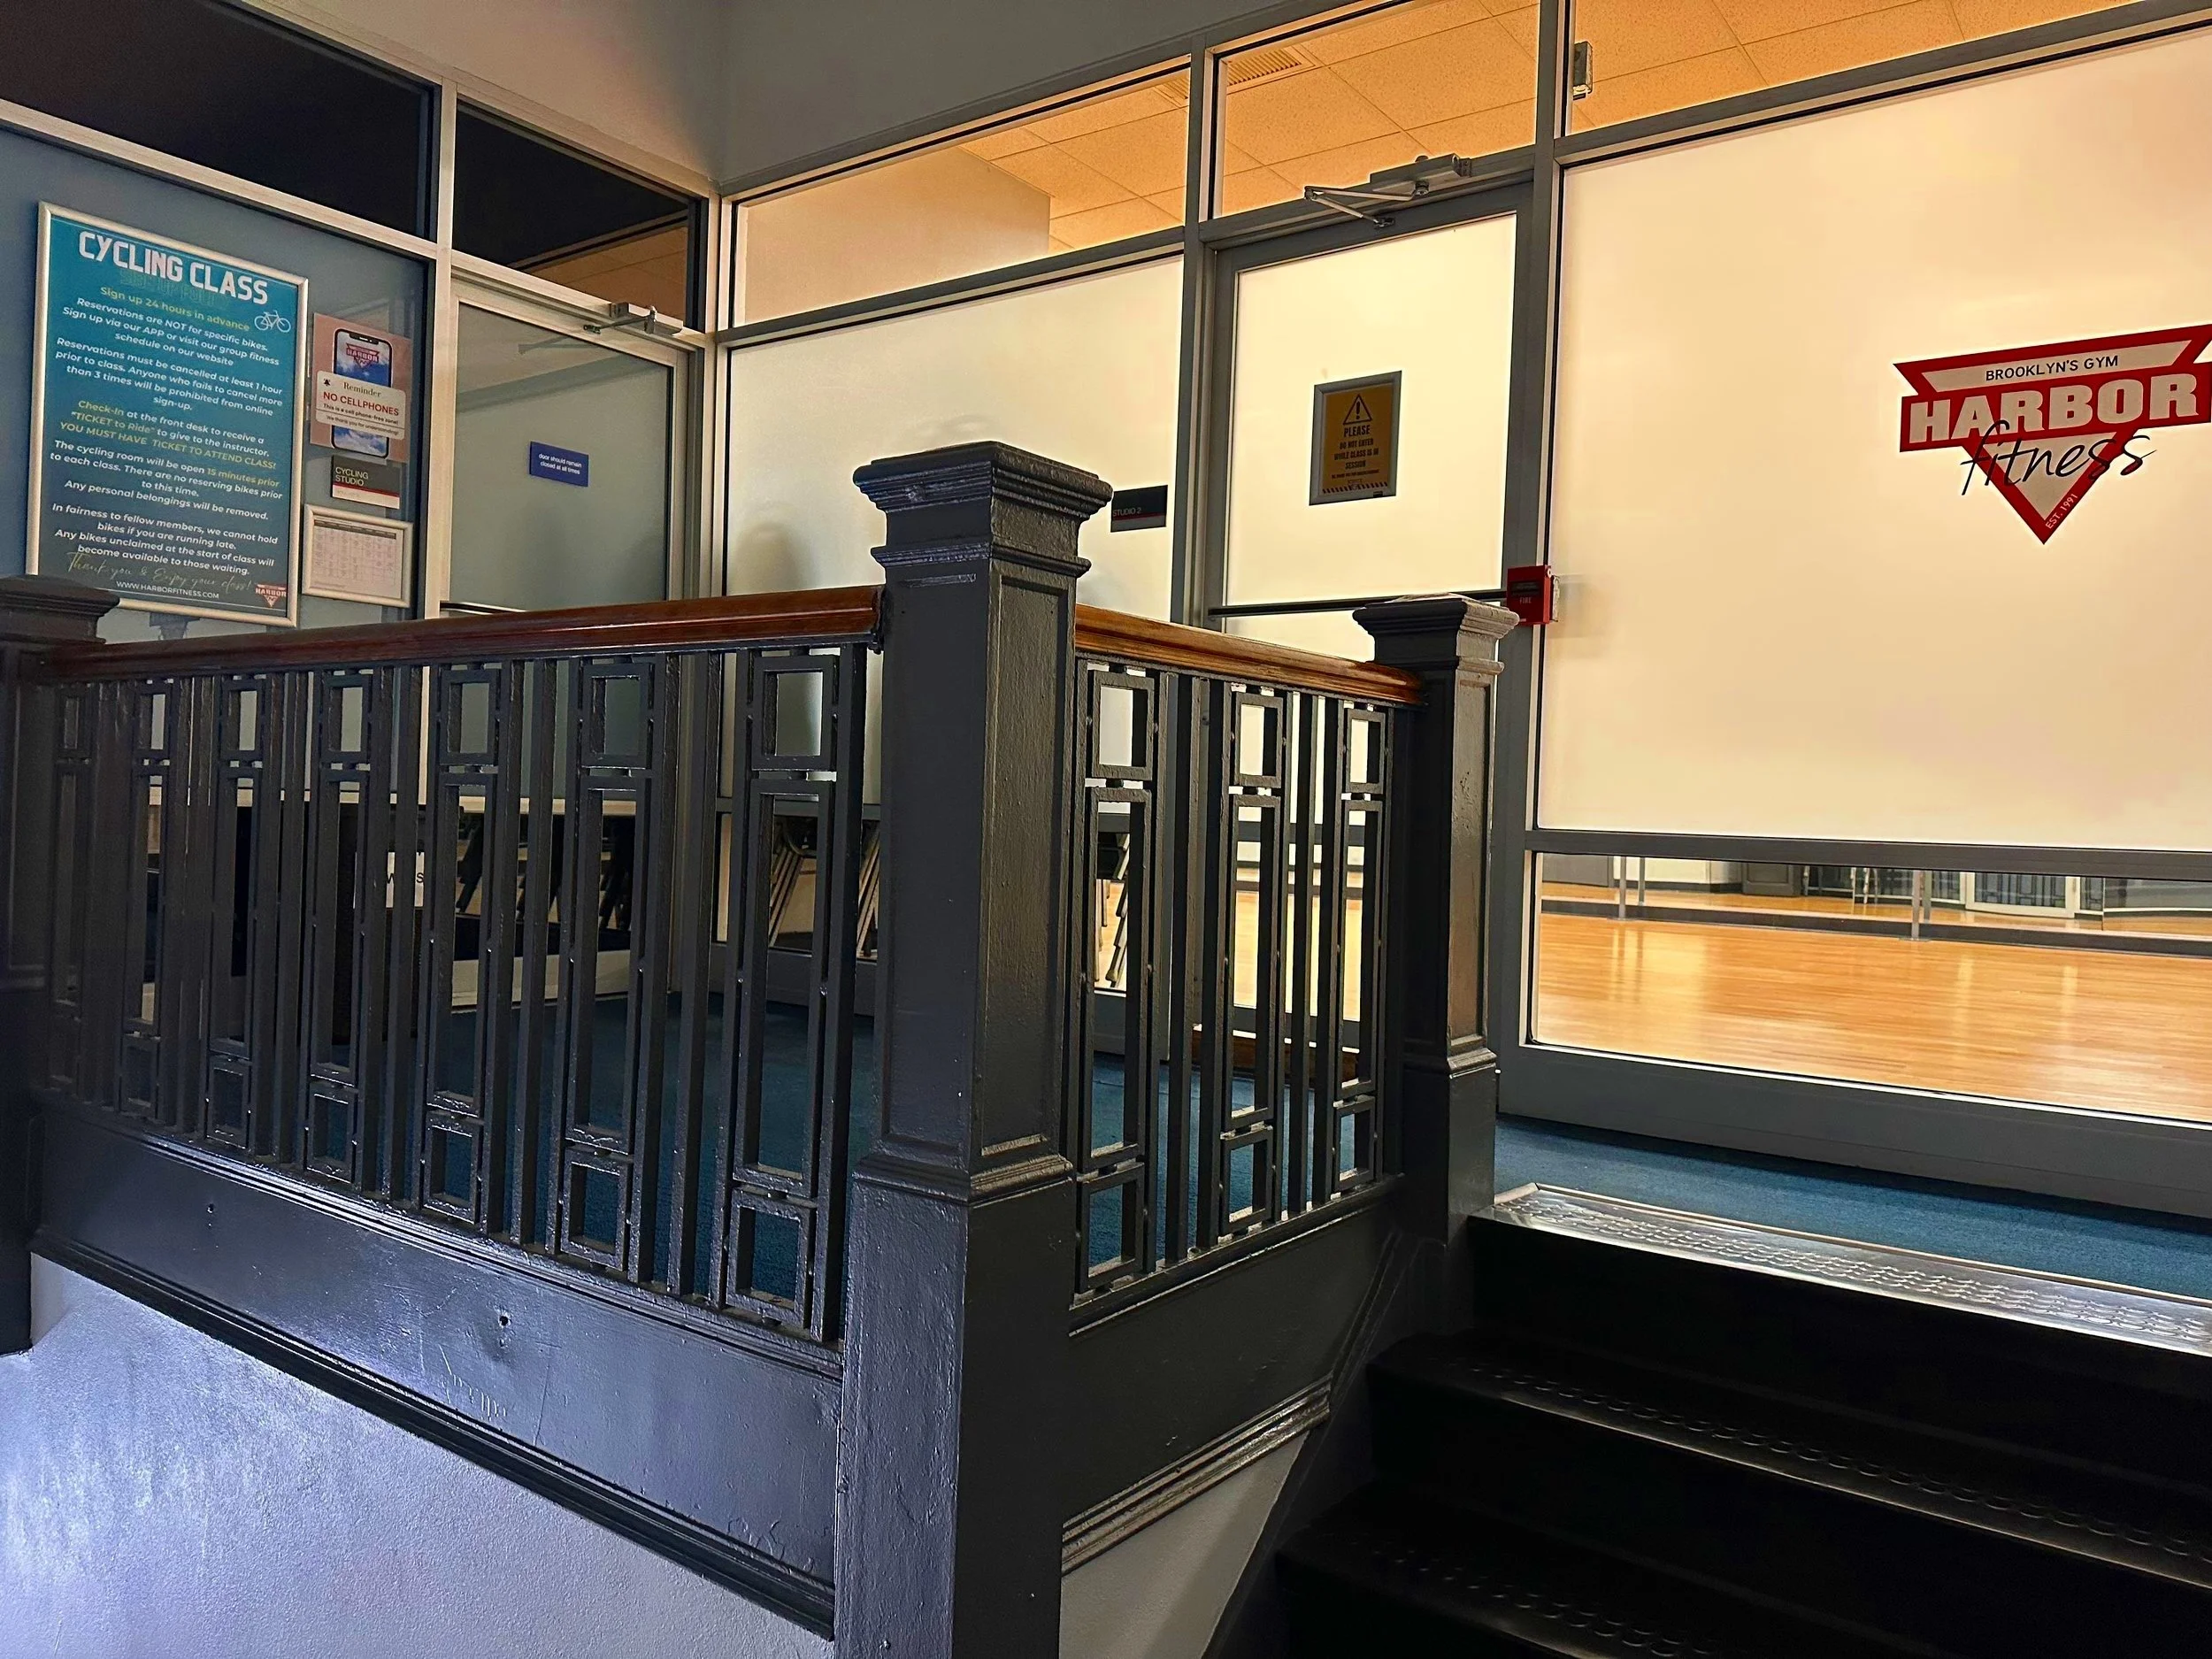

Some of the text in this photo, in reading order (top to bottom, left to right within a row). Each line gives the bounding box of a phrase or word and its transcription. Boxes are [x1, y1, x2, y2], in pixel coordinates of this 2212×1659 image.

[79, 231, 183, 281] CYCLING
[189, 262, 267, 304] CLASS
[77, 297, 267, 350] Reservations are NOT for specific bikes.
[100, 287, 250, 331] Sign up 24 hours in advance
[62, 307, 86, 319] Sign
[88, 314, 103, 324] up
[105, 318, 121, 327] via
[123, 323, 141, 332] our
[142, 326, 165, 336] APP
[179, 336, 199, 346] visit
[219, 346, 247, 358] group
[250, 352, 279, 365] fitness
[115, 334, 161, 349] schedule
[178, 348, 195, 357] our
[196, 352, 234, 365] website
[55, 351, 81, 362] prior
[97, 360, 126, 372] class.
[127, 366, 166, 380] Anyone
[169, 376, 190, 386] who
[192, 380, 212, 391] fails
[227, 389, 257, 401] cancel
[258, 396, 282, 406] more
[57, 337, 125, 359] Reservations
[127, 355, 153, 365] must
[155, 359, 168, 368] be
[170, 365, 217, 380] cancelled
[231, 377, 253, 388] least
[261, 384, 282, 395] hour
[1985, 355, 2118, 380] BROOKLYN'S GYM
[66, 365, 91, 377] than
[103, 373, 132, 385] times
[134, 380, 152, 389] will
[168, 388, 219, 403] prohibited
[221, 398, 242, 409] from
[245, 405, 273, 416] online
[153, 396, 192, 411] sign-up.
[324, 392, 399, 416] NO CELLPHONES
[343, 382, 381, 397] Reminder
[356, 411, 384, 421] phone-free
[1909, 373, 2199, 444] HARBOR
[140, 413, 157, 422] the
[159, 416, 184, 427] front
[186, 422, 208, 433] desk
[223, 431, 256, 442] receive
[1344, 425, 1370, 437] PLEASE
[60, 421, 276, 469] YOU MUST HAVE TICKET TO ATTEND CLASS!
[169, 432, 190, 441] give
[204, 438, 220, 447] the
[223, 441, 269, 457] instructor.
[1960, 419, 2157, 495] fitness
[55, 440, 74, 450] The
[76, 445, 114, 458] cycling
[116, 453, 143, 463] room
[146, 457, 164, 466] will
[165, 460, 179, 469] be
[180, 465, 204, 473] open
[218, 472, 256, 482] minutes
[335, 467, 368, 480] CYCLING
[64, 456, 90, 465] each
[93, 460, 120, 471] class.
[125, 465, 152, 476] There
[188, 478, 232, 492] reserving
[234, 484, 258, 495] bikes
[260, 490, 282, 499] prior
[154, 482, 173, 492] this
[175, 486, 199, 497] time.
[335, 474, 364, 487] STUDIO
[64, 480, 87, 491] Any
[88, 485, 134, 497] personal
[136, 491, 190, 508] belongings
[211, 503, 224, 512] be
[226, 508, 268, 519] removed.
[1113, 508, 1136, 517] STUDIO
[2046, 494, 2078, 528] EST. 1991
[65, 504, 107, 518] fairness
[123, 514, 154, 525] fellow
[156, 520, 204, 534] members,
[223, 531, 255, 541] cannot
[257, 534, 278, 544] hold
[97, 522, 125, 533] bikes
[175, 535, 214, 548] running
[216, 540, 236, 549] late.
[54, 529, 77, 540] Any
[79, 532, 106, 542] bikes
[109, 538, 163, 550] unclaimed
[196, 550, 219, 559] start
[233, 555, 256, 564] class
[78, 544, 119, 557] become
[122, 552, 168, 564] available
[183, 559, 210, 569] those
[212, 565, 250, 575] waiting.
[116, 580, 219, 598] WWW.HARBORFITNESS.COM
